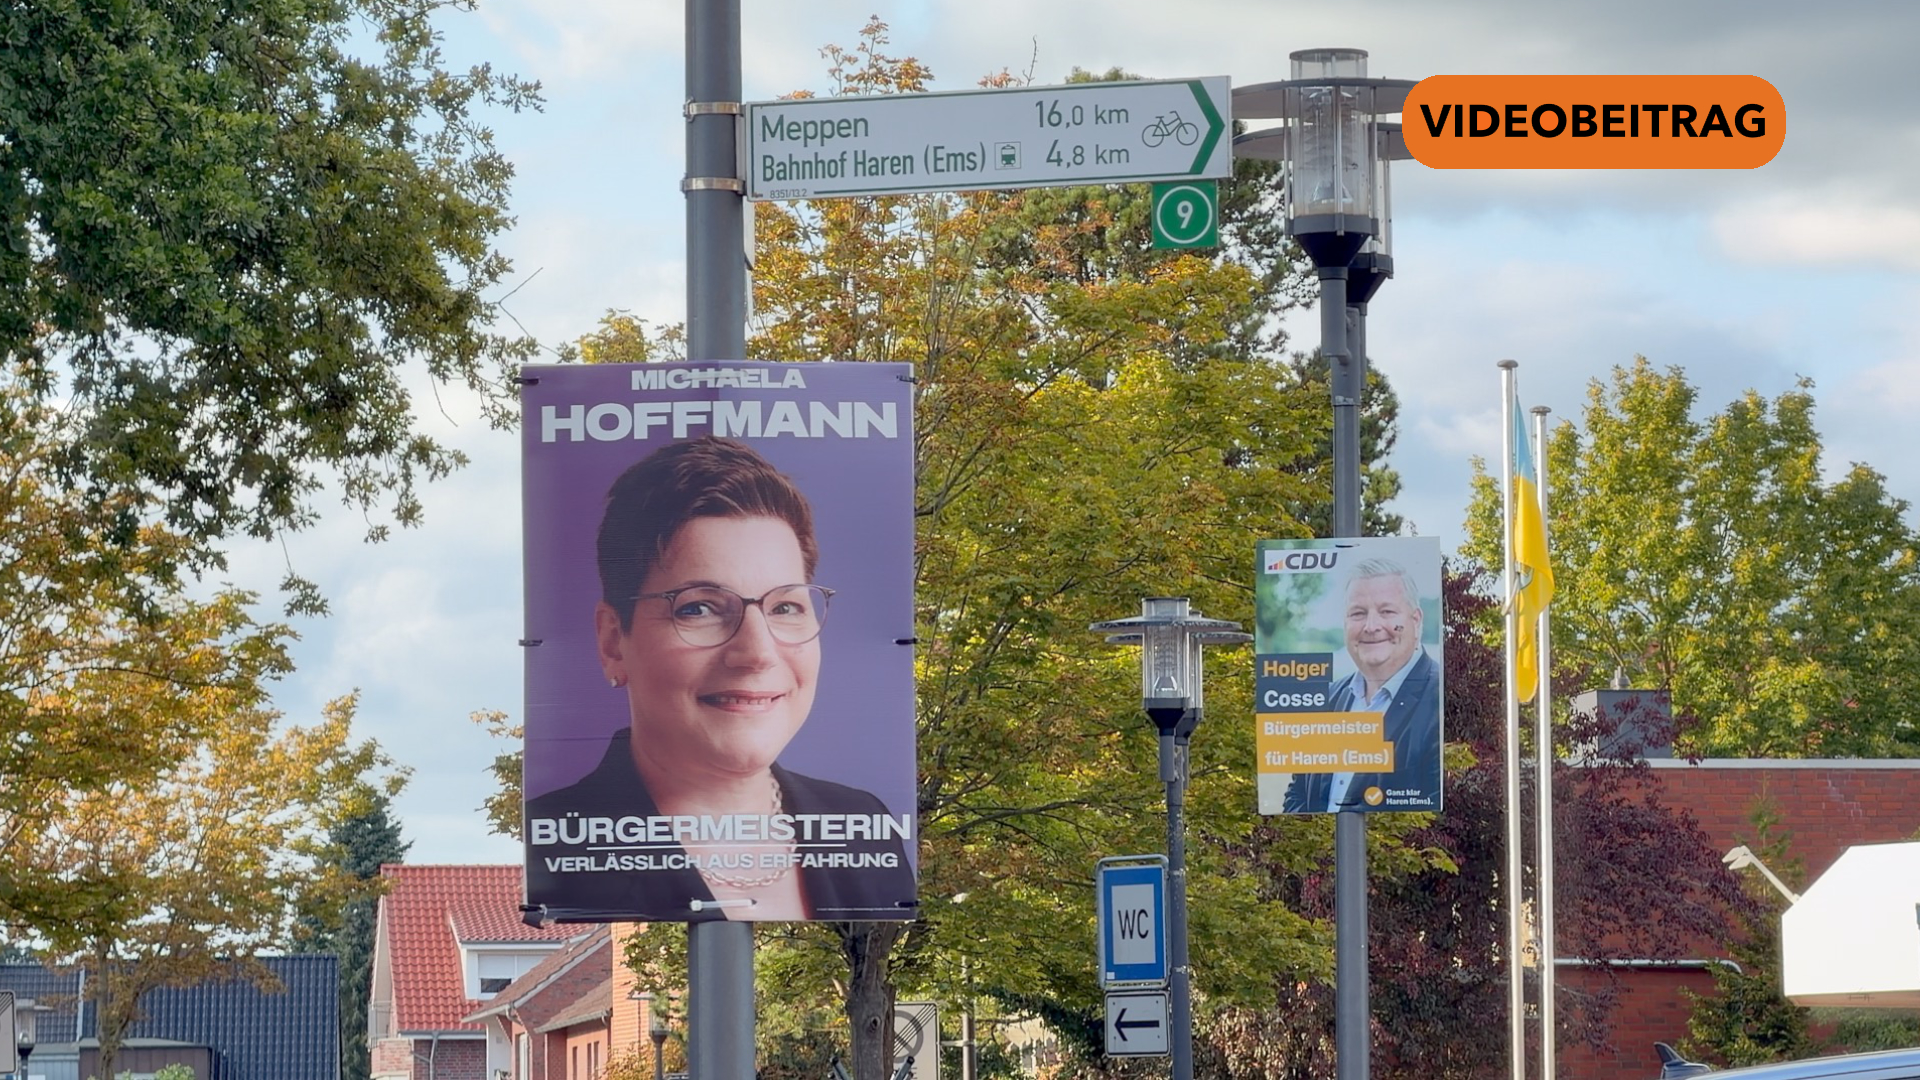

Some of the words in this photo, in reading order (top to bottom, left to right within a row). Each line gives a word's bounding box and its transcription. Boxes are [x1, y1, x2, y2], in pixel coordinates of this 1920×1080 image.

[1036, 99, 1084, 128] 16,0
[1095, 103, 1130, 126] km
[761, 114, 869, 147] Meppen
[762, 151, 847, 183] Bahnhof
[853, 147, 914, 177] Haren
[923, 142, 987, 175] (Ems)
[1045, 139, 1086, 169] 4,8
[1095, 143, 1130, 165] km
[1176, 200, 1193, 229] 9
[630, 368, 807, 391] MICHAELA
[541, 400, 898, 443] HOFFMANN
[1285, 552, 1338, 570] CDU
[1263, 660, 1329, 681] Holger
[1264, 689, 1326, 707] Cosse
[1264, 720, 1379, 738] Bürgermeister
[1265, 750, 1287, 766] für
[1291, 751, 1338, 766] Haren
[1342, 749, 1389, 766] (Ems)
[1386, 788, 1405, 796] Ganz
[1406, 788, 1421, 796] klar
[1386, 797, 1409, 805] Haren
[531, 812, 912, 846] BÜRGERMEISTERIN
[544, 851, 701, 873] VERLÄSSLICH
[708, 853, 754, 869] AUS
[760, 852, 898, 869] ERFAHRUNG
[1117, 908, 1149, 940] WC
